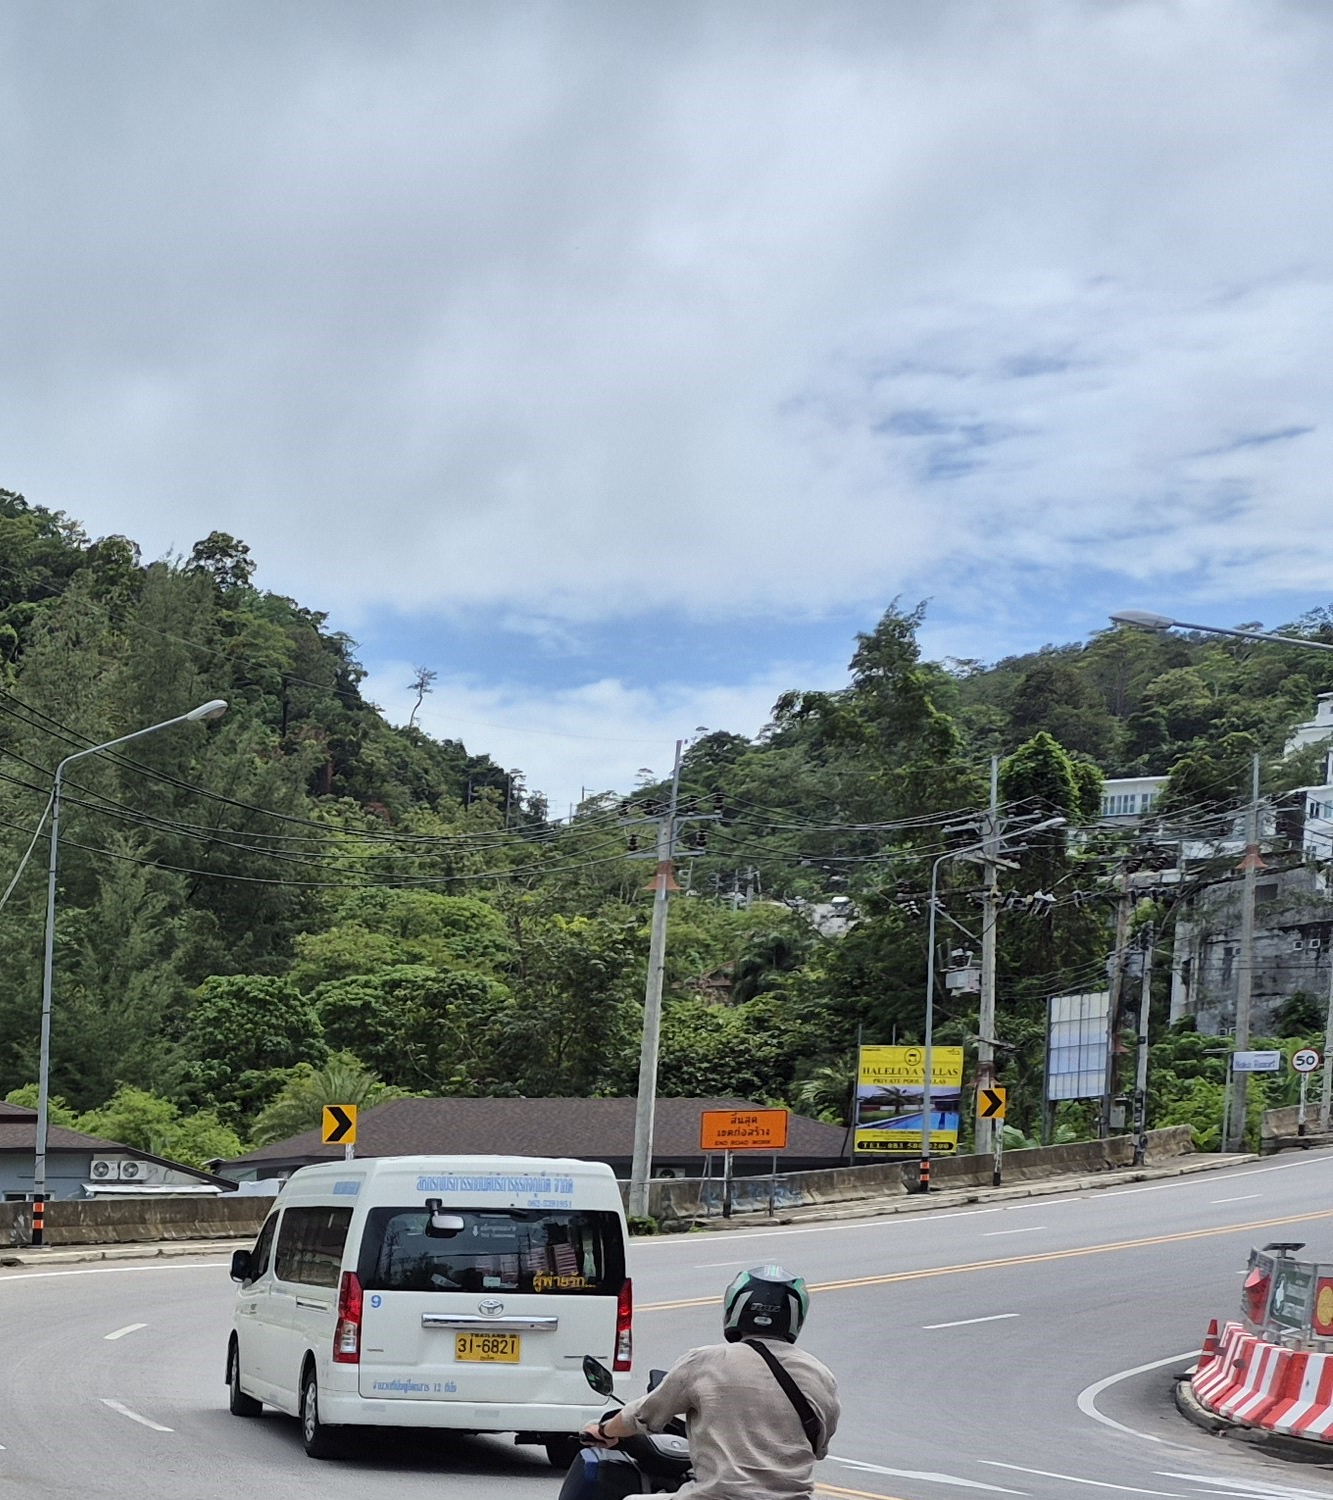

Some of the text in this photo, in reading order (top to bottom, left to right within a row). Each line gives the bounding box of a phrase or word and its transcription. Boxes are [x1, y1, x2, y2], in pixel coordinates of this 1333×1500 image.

[1296, 1055, 1316, 1067] 50
[862, 1067, 959, 1076] HALELUYA VLLAS
[371, 1294, 382, 1309] 9
[457, 1338, 516, 1355] 31-6821
